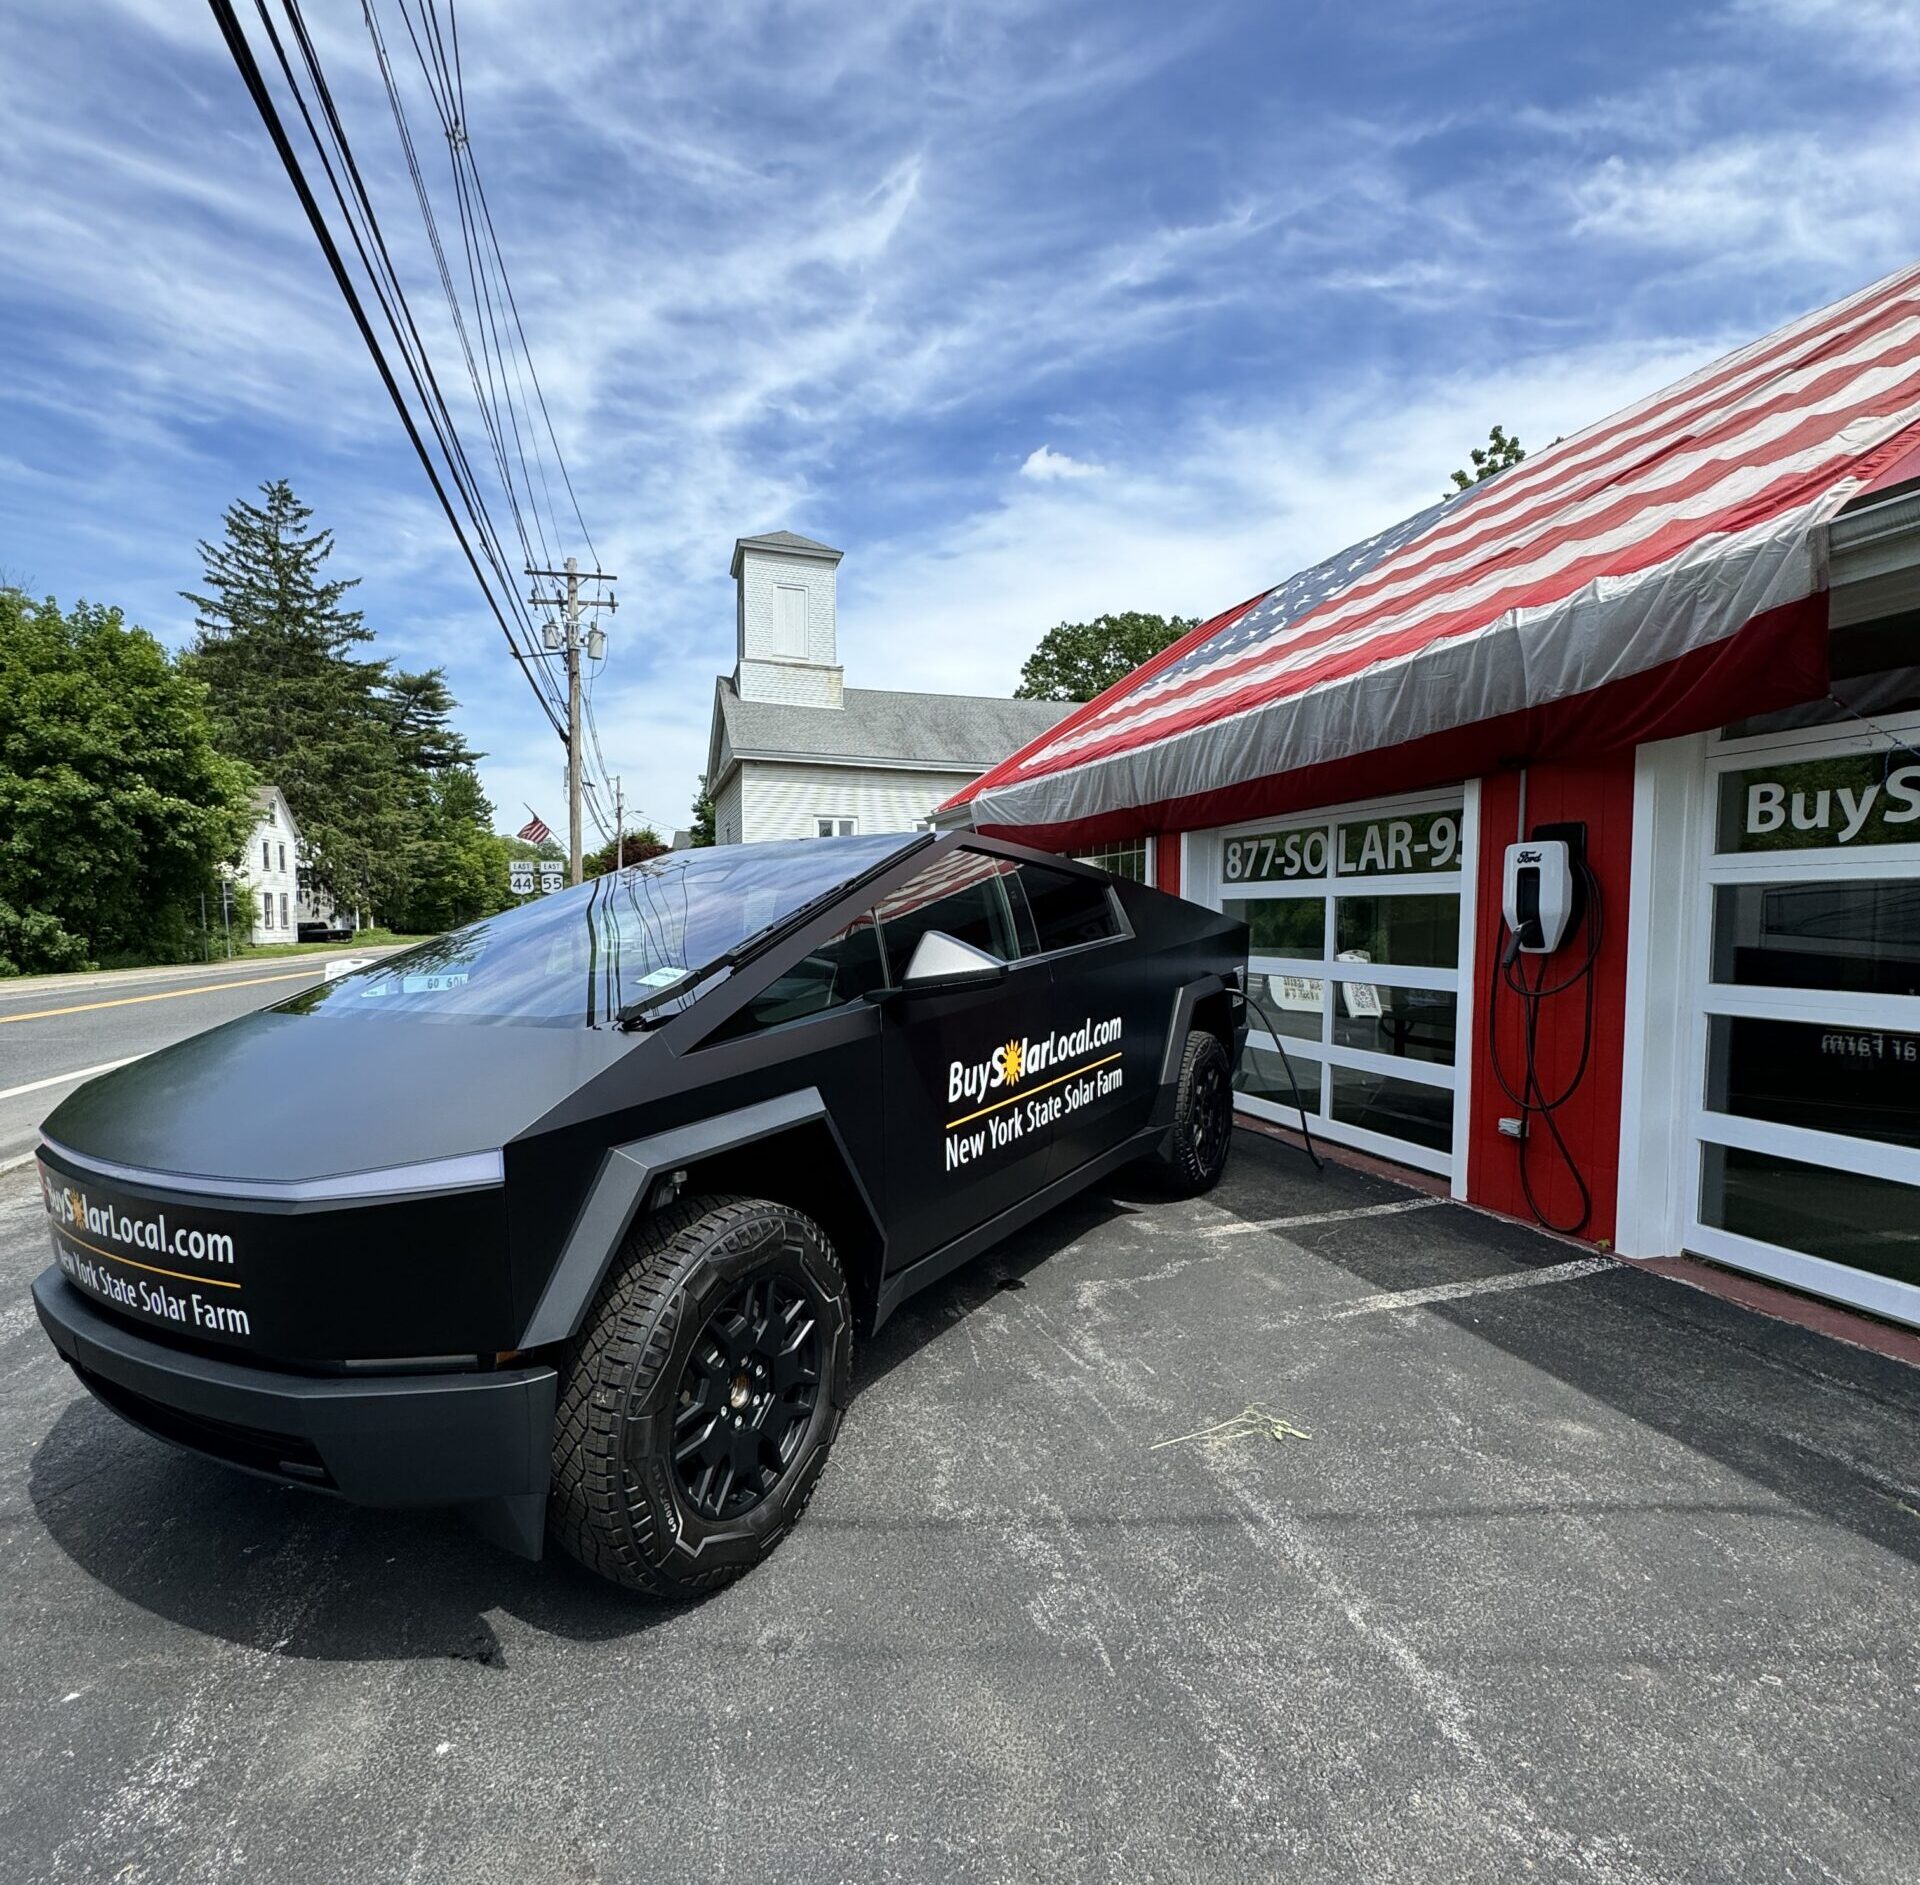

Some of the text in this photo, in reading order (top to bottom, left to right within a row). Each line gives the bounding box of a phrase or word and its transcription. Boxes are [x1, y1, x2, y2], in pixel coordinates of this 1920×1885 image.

[1225, 816, 1463, 880] 877-SOLAR-9
[1517, 850, 1543, 864] Ford
[512, 877, 532, 890] 44
[543, 877, 562, 890] 55
[945, 1067, 1123, 1171] New York State Solar Farm
[73, 1251, 100, 1292] York
[98, 1265, 138, 1308] State
[138, 1280, 187, 1323] Solar
[191, 1293, 251, 1336] Farm
